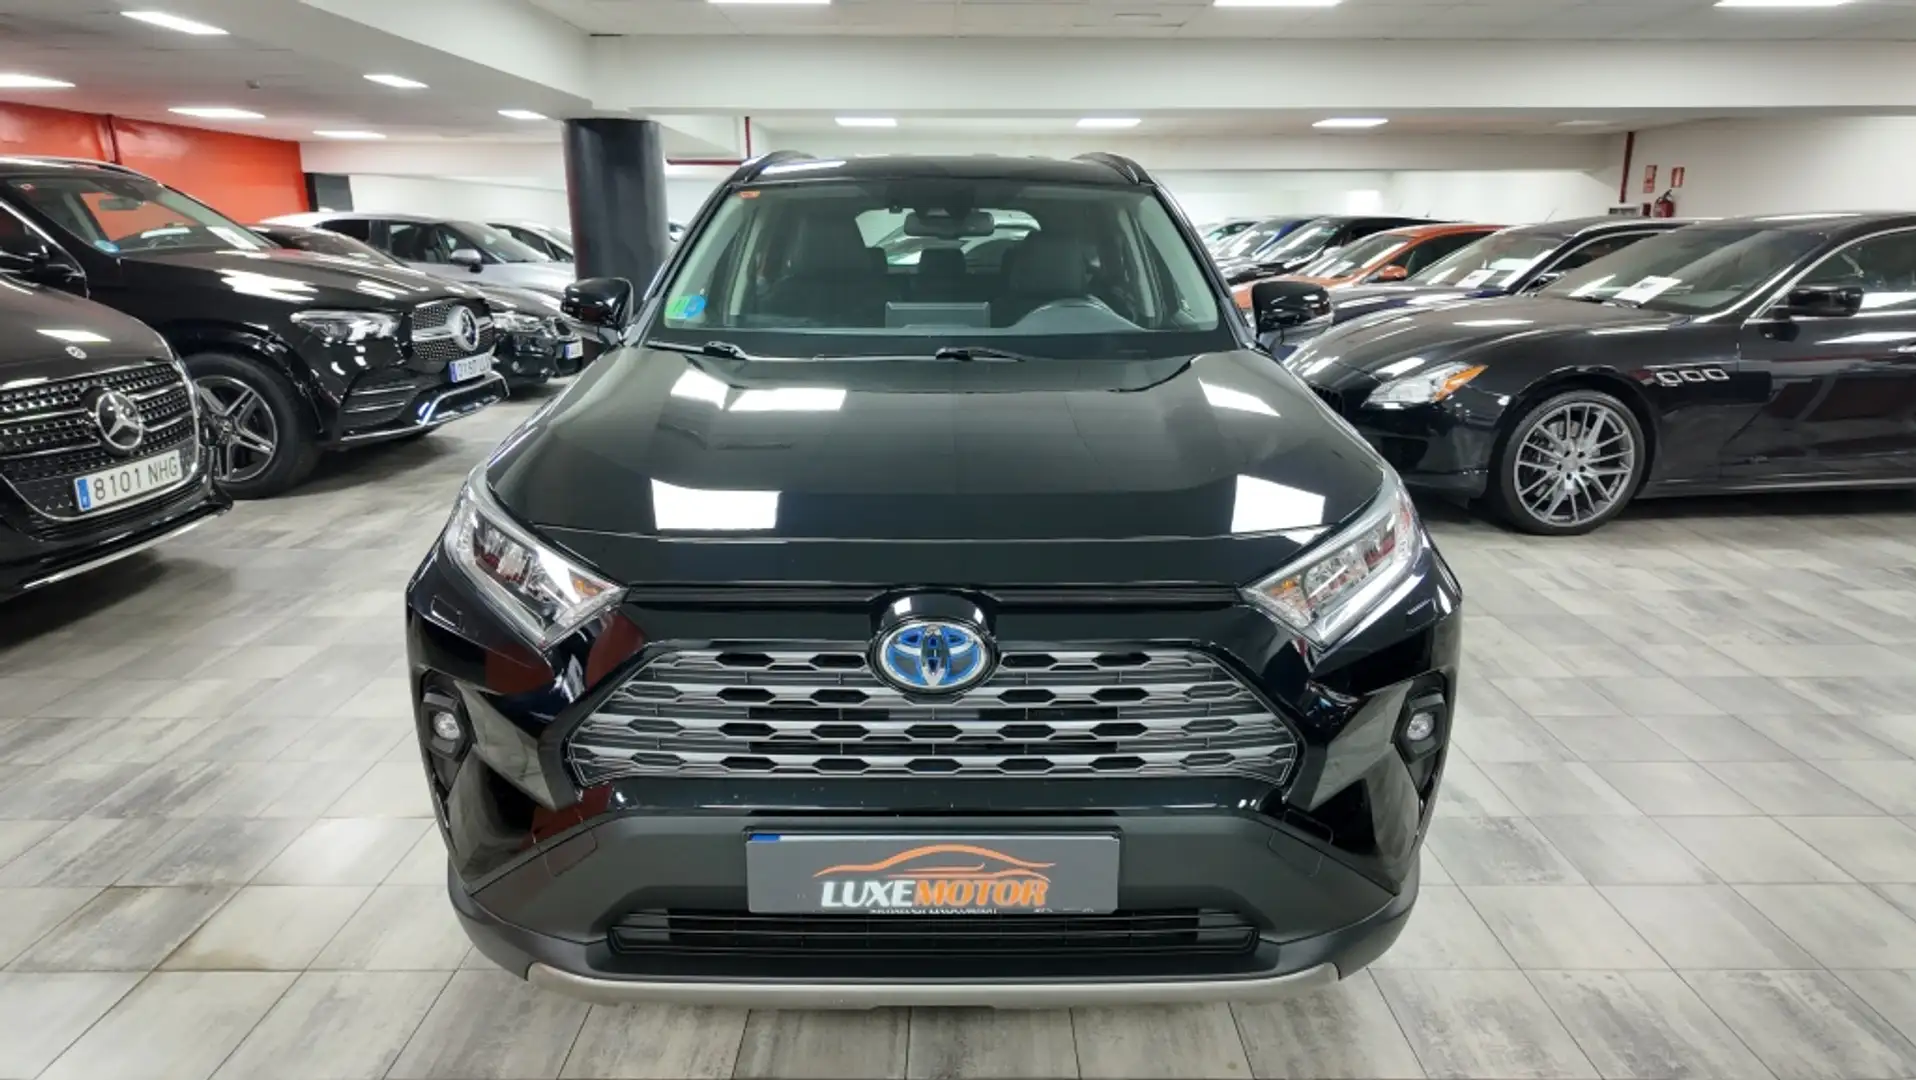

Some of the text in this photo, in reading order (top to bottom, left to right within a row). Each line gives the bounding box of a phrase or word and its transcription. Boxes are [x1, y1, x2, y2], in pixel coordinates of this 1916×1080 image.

[93, 456, 178, 501] 8101 NHG
[820, 879, 1049, 908] LUXEMOTOR
